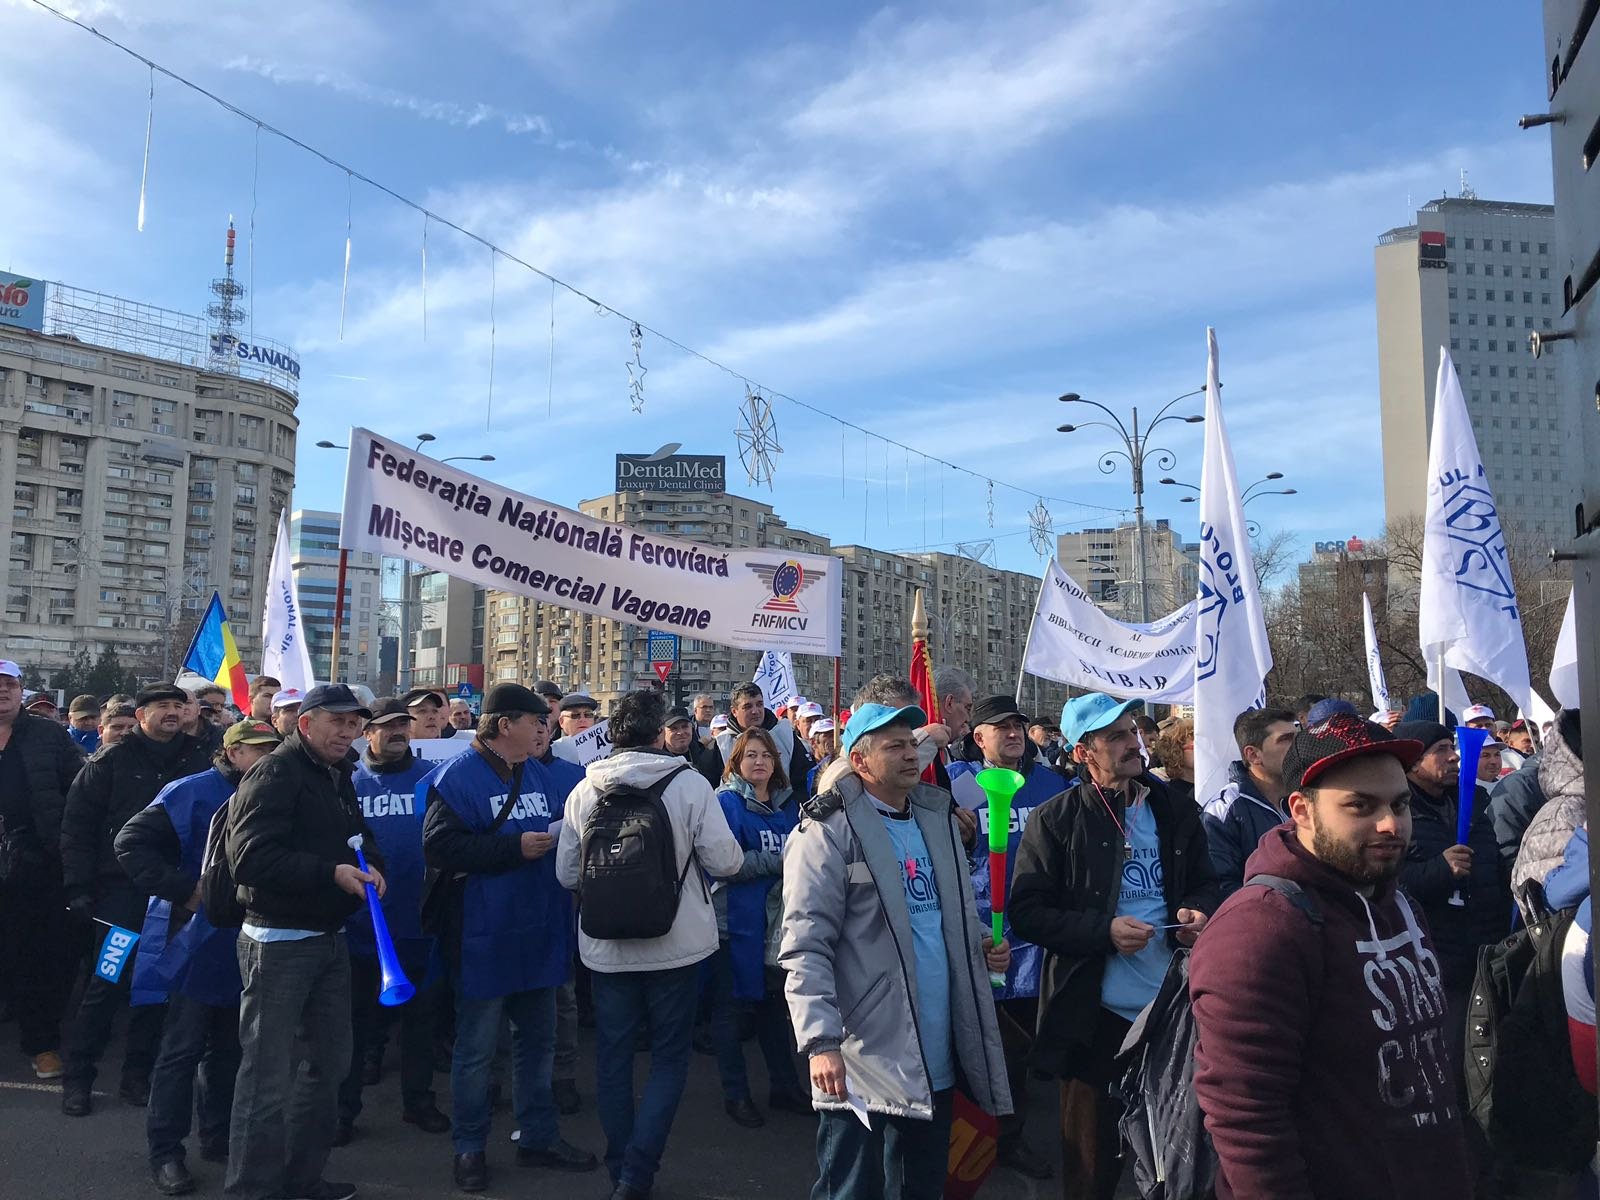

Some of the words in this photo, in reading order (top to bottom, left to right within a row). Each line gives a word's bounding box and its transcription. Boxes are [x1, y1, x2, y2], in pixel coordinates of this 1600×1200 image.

[1420, 260, 1448, 269] BRD
[236, 342, 300, 379] SANADOR
[619, 461, 722, 479] DentalMed
[619, 480, 656, 490] Luxury
[659, 480, 691, 489] Dental
[693, 480, 723, 490] Clinic
[367, 439, 492, 517] Federația
[497, 496, 623, 559] Națională
[1314, 540, 1347, 554] BCR
[367, 504, 465, 563] Mișcare
[471, 543, 607, 607] Comercial
[611, 585, 712, 631] Vagoane
[751, 612, 809, 631] FNFMCV
[1048, 612, 1103, 648] BIBLTECII
[1129, 633, 1143, 642] AL
[588, 727, 604, 740] NICI
[100, 931, 133, 977] BNS
